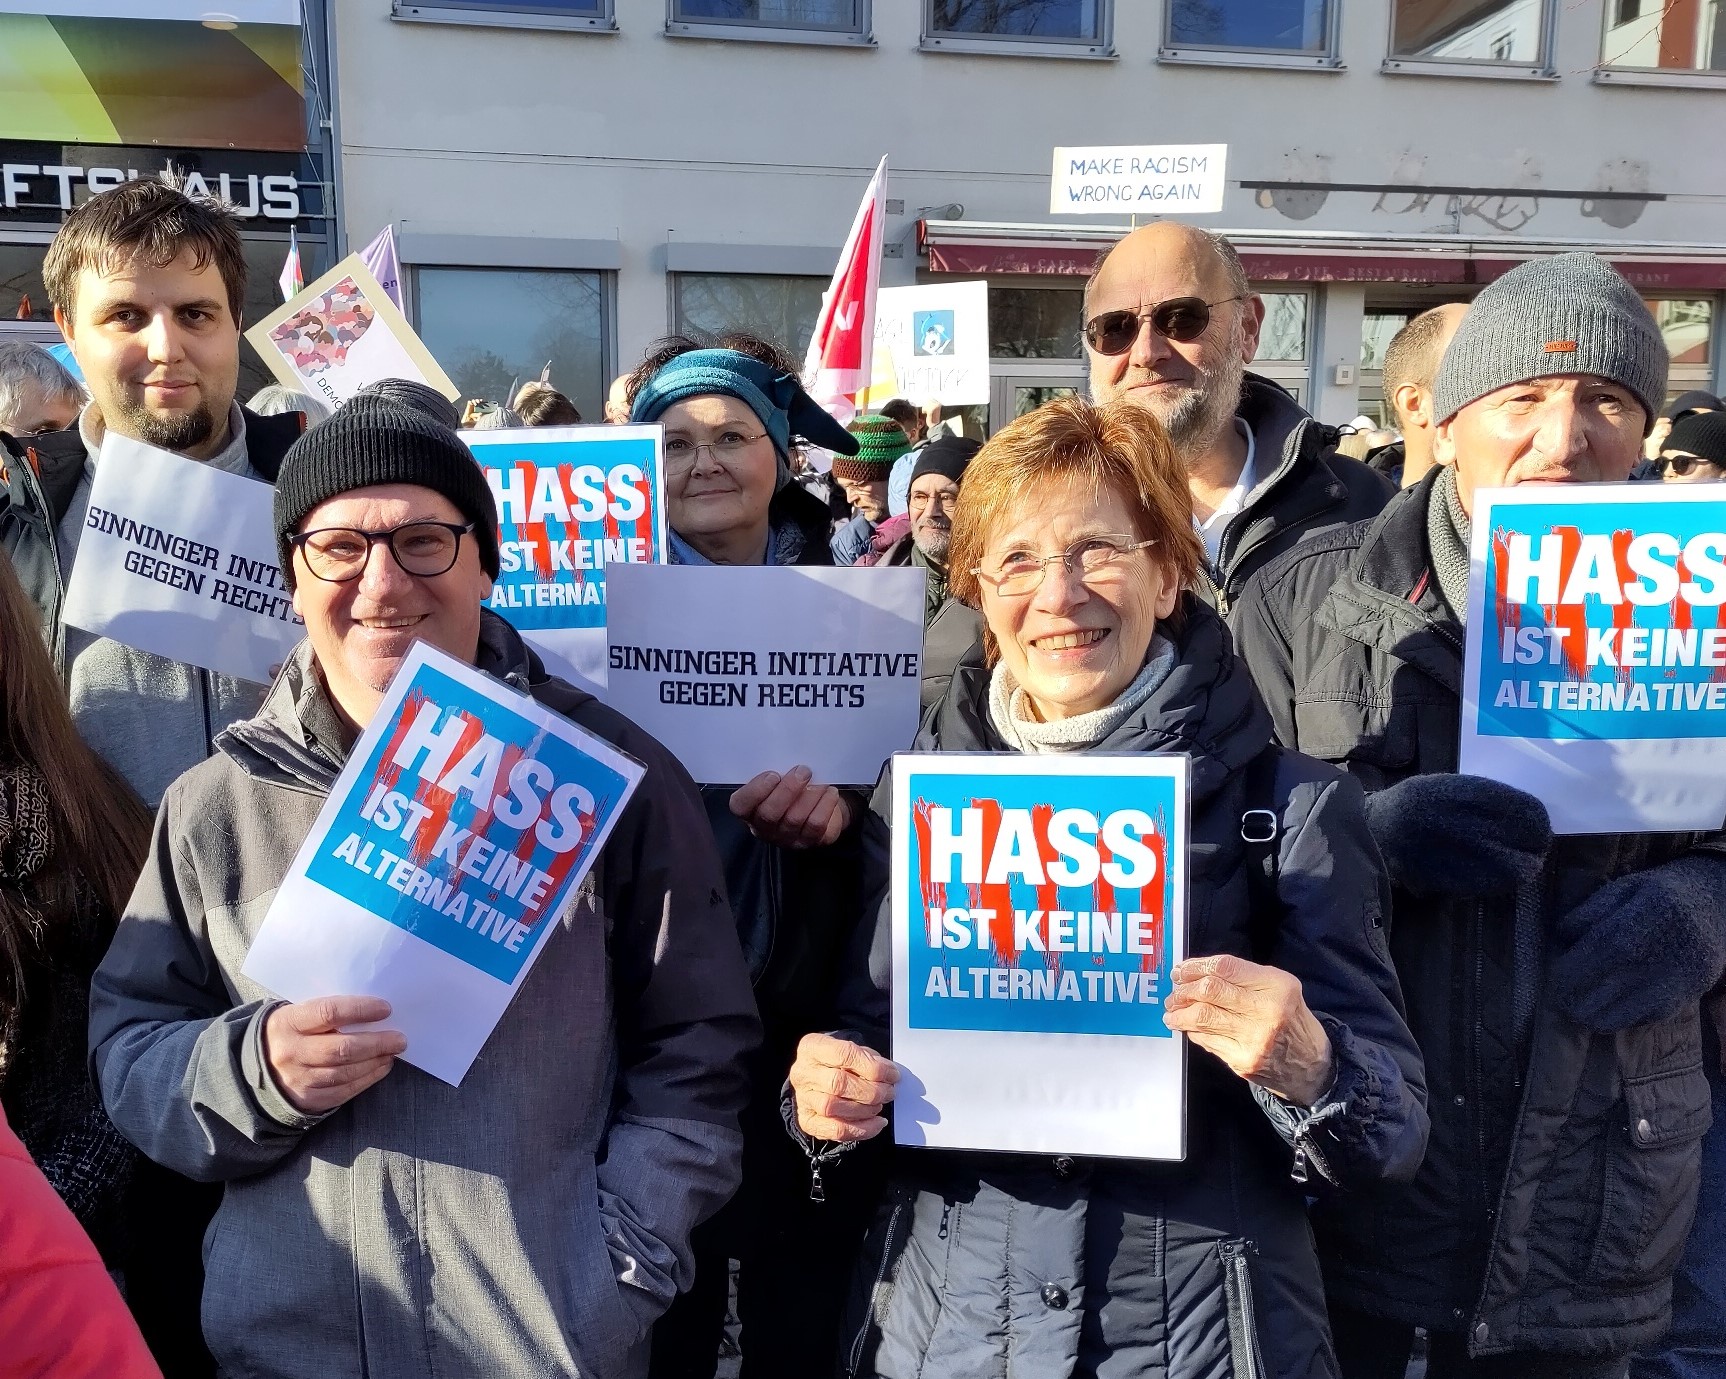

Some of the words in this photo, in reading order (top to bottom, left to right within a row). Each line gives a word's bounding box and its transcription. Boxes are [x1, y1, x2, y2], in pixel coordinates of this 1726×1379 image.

[1070, 158, 1123, 175] MAKE
[1131, 157, 1207, 174] RACISM
[1069, 185, 1132, 201] WRONG
[1138, 184, 1201, 200] AGAIN
[486, 464, 646, 524] HASS
[86, 505, 220, 571] SINNINGER
[226, 554, 287, 592] INIT
[499, 541, 538, 573] ST
[550, 538, 648, 571] KEINE
[1506, 532, 1726, 607] HASS
[124, 550, 206, 595] GEGEN
[609, 645, 757, 676] SINNINGER
[767, 651, 918, 678] INITIATIVE
[1502, 626, 1571, 665] IST
[1586, 628, 1726, 667] KEINE
[659, 681, 748, 707] GEGEN
[757, 683, 865, 708] RECHTS
[1494, 679, 1726, 711] ALTERNATIVE
[391, 700, 595, 854] HASS
[359, 782, 432, 842] IST
[431, 824, 555, 911] KEINE
[930, 807, 1157, 889] HASS
[332, 832, 532, 954] ALTERNATIVE
[929, 907, 997, 951] IST
[1013, 910, 1154, 955] KEINE
[924, 966, 1159, 1005] ALTERNATIVE
